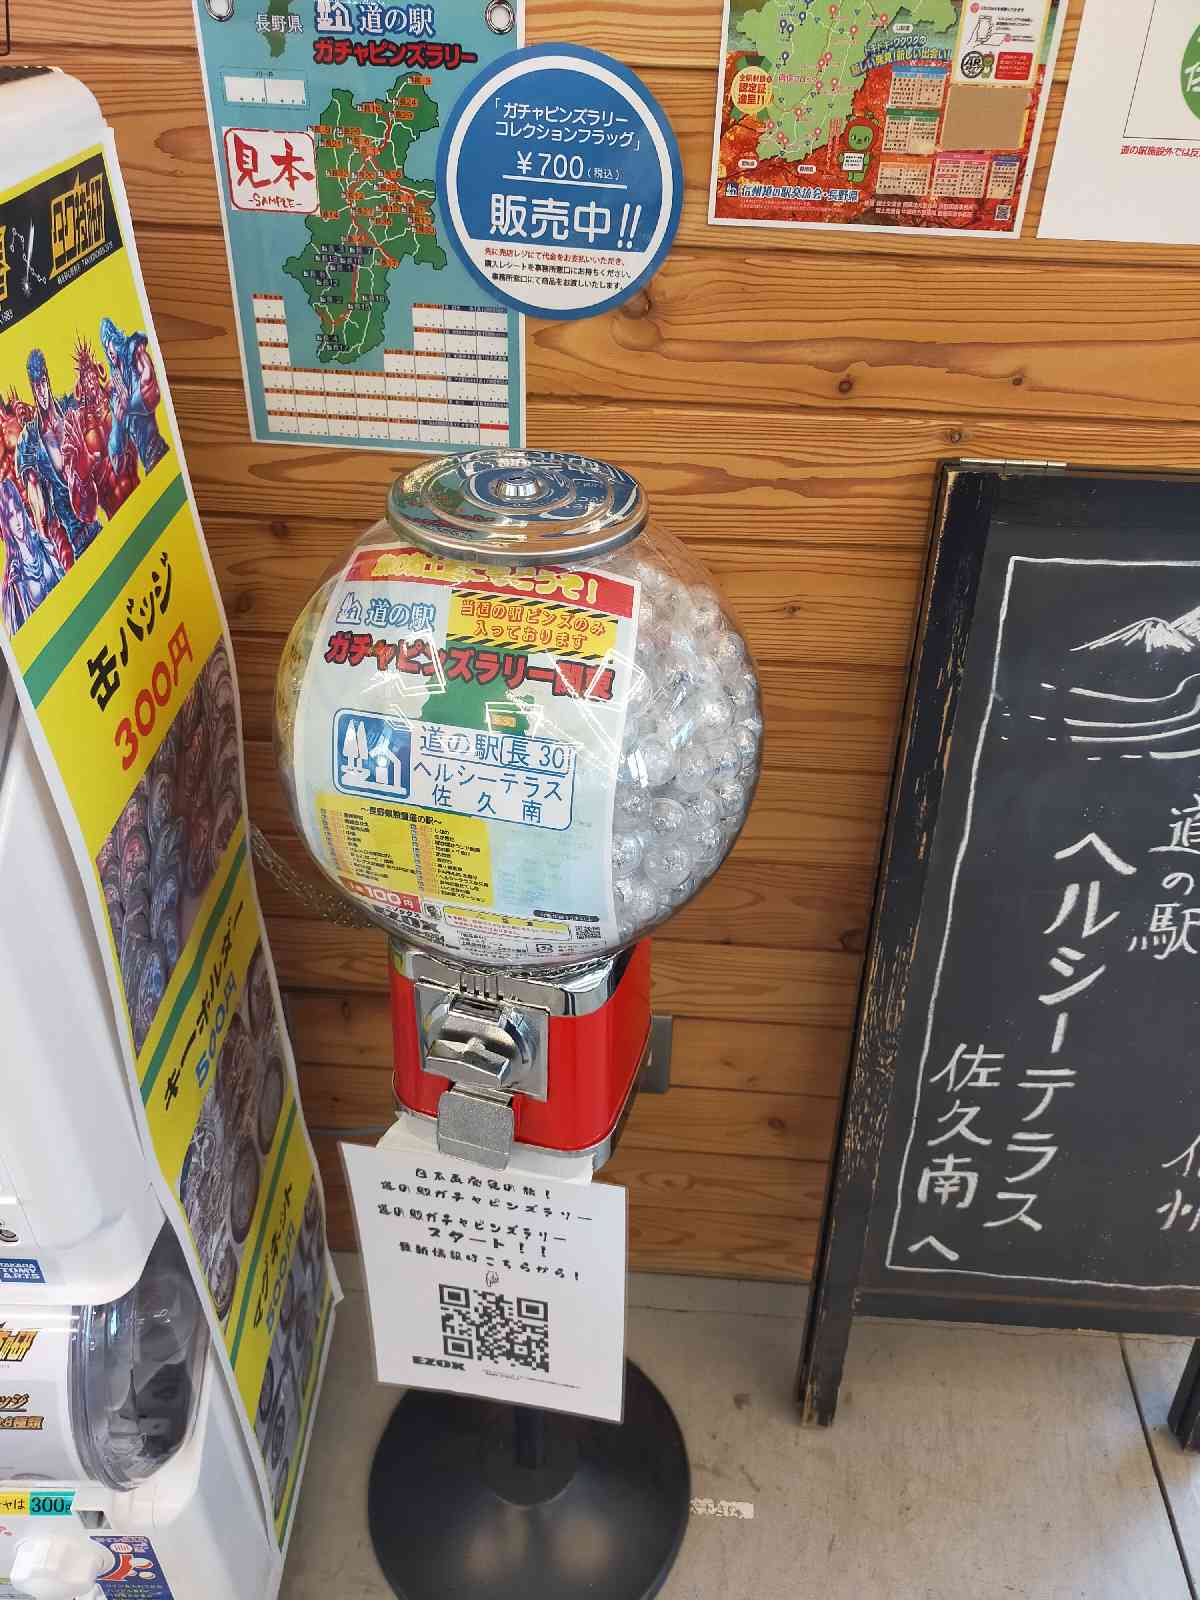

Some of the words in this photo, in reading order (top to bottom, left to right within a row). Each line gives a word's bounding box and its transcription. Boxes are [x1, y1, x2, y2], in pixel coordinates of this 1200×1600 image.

[256, 14, 304, 32] 長野県
[359, 3, 433, 36] 道の駅
[313, 37, 478, 70] ガチャピンズラリー
[234, 134, 315, 191] 見本
[86, 552, 172, 712] 缶バッジ
[365, 597, 436, 634] 道の駅
[474, 620, 588, 650] 入っております
[115, 622, 193, 771] 300円
[420, 725, 499, 762] 道の駅
[413, 760, 563, 802] ヘルシーテラス
[983, 833, 1137, 1231] ヘルシーテラス
